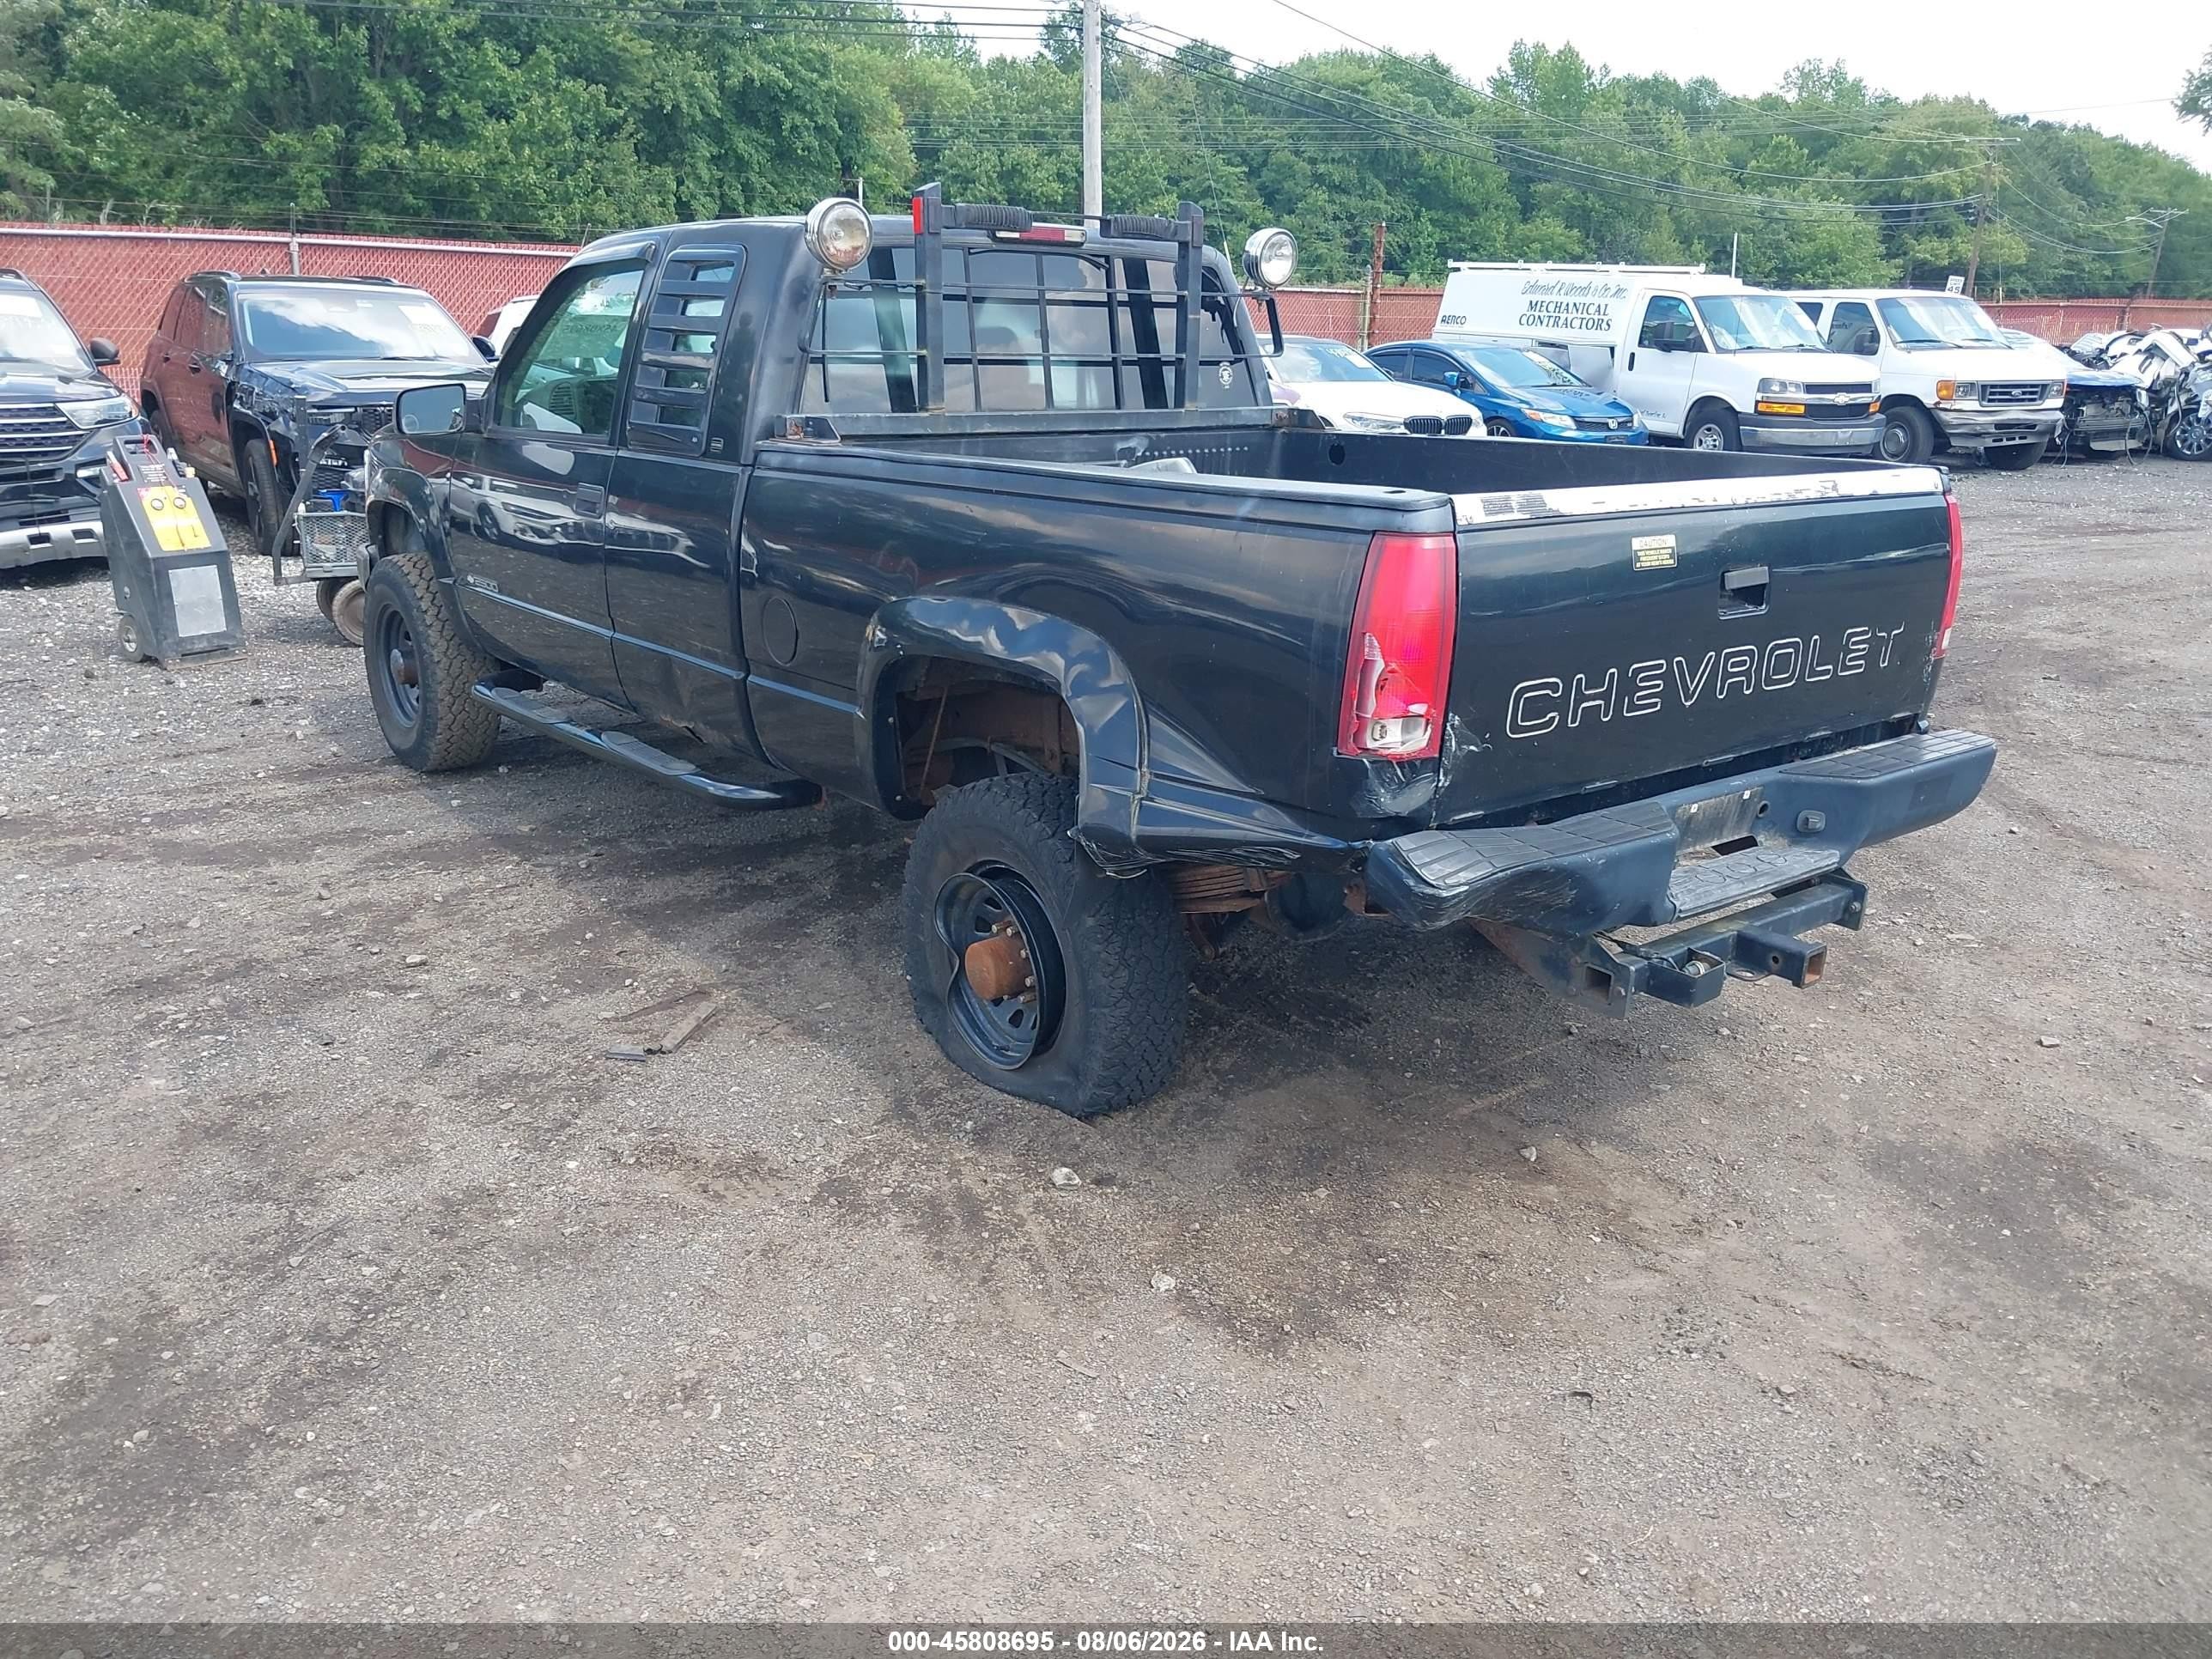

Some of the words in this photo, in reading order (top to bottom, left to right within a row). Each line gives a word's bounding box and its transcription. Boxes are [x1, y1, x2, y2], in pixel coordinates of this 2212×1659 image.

[1521, 279, 1559, 295] Edward
[1564, 281, 1592, 297] Woods
[1526, 300, 1609, 316] MECHANICAL
[1518, 313, 1613, 331] CONTRACTORS
[1505, 621, 1905, 739] CHEVROLET
